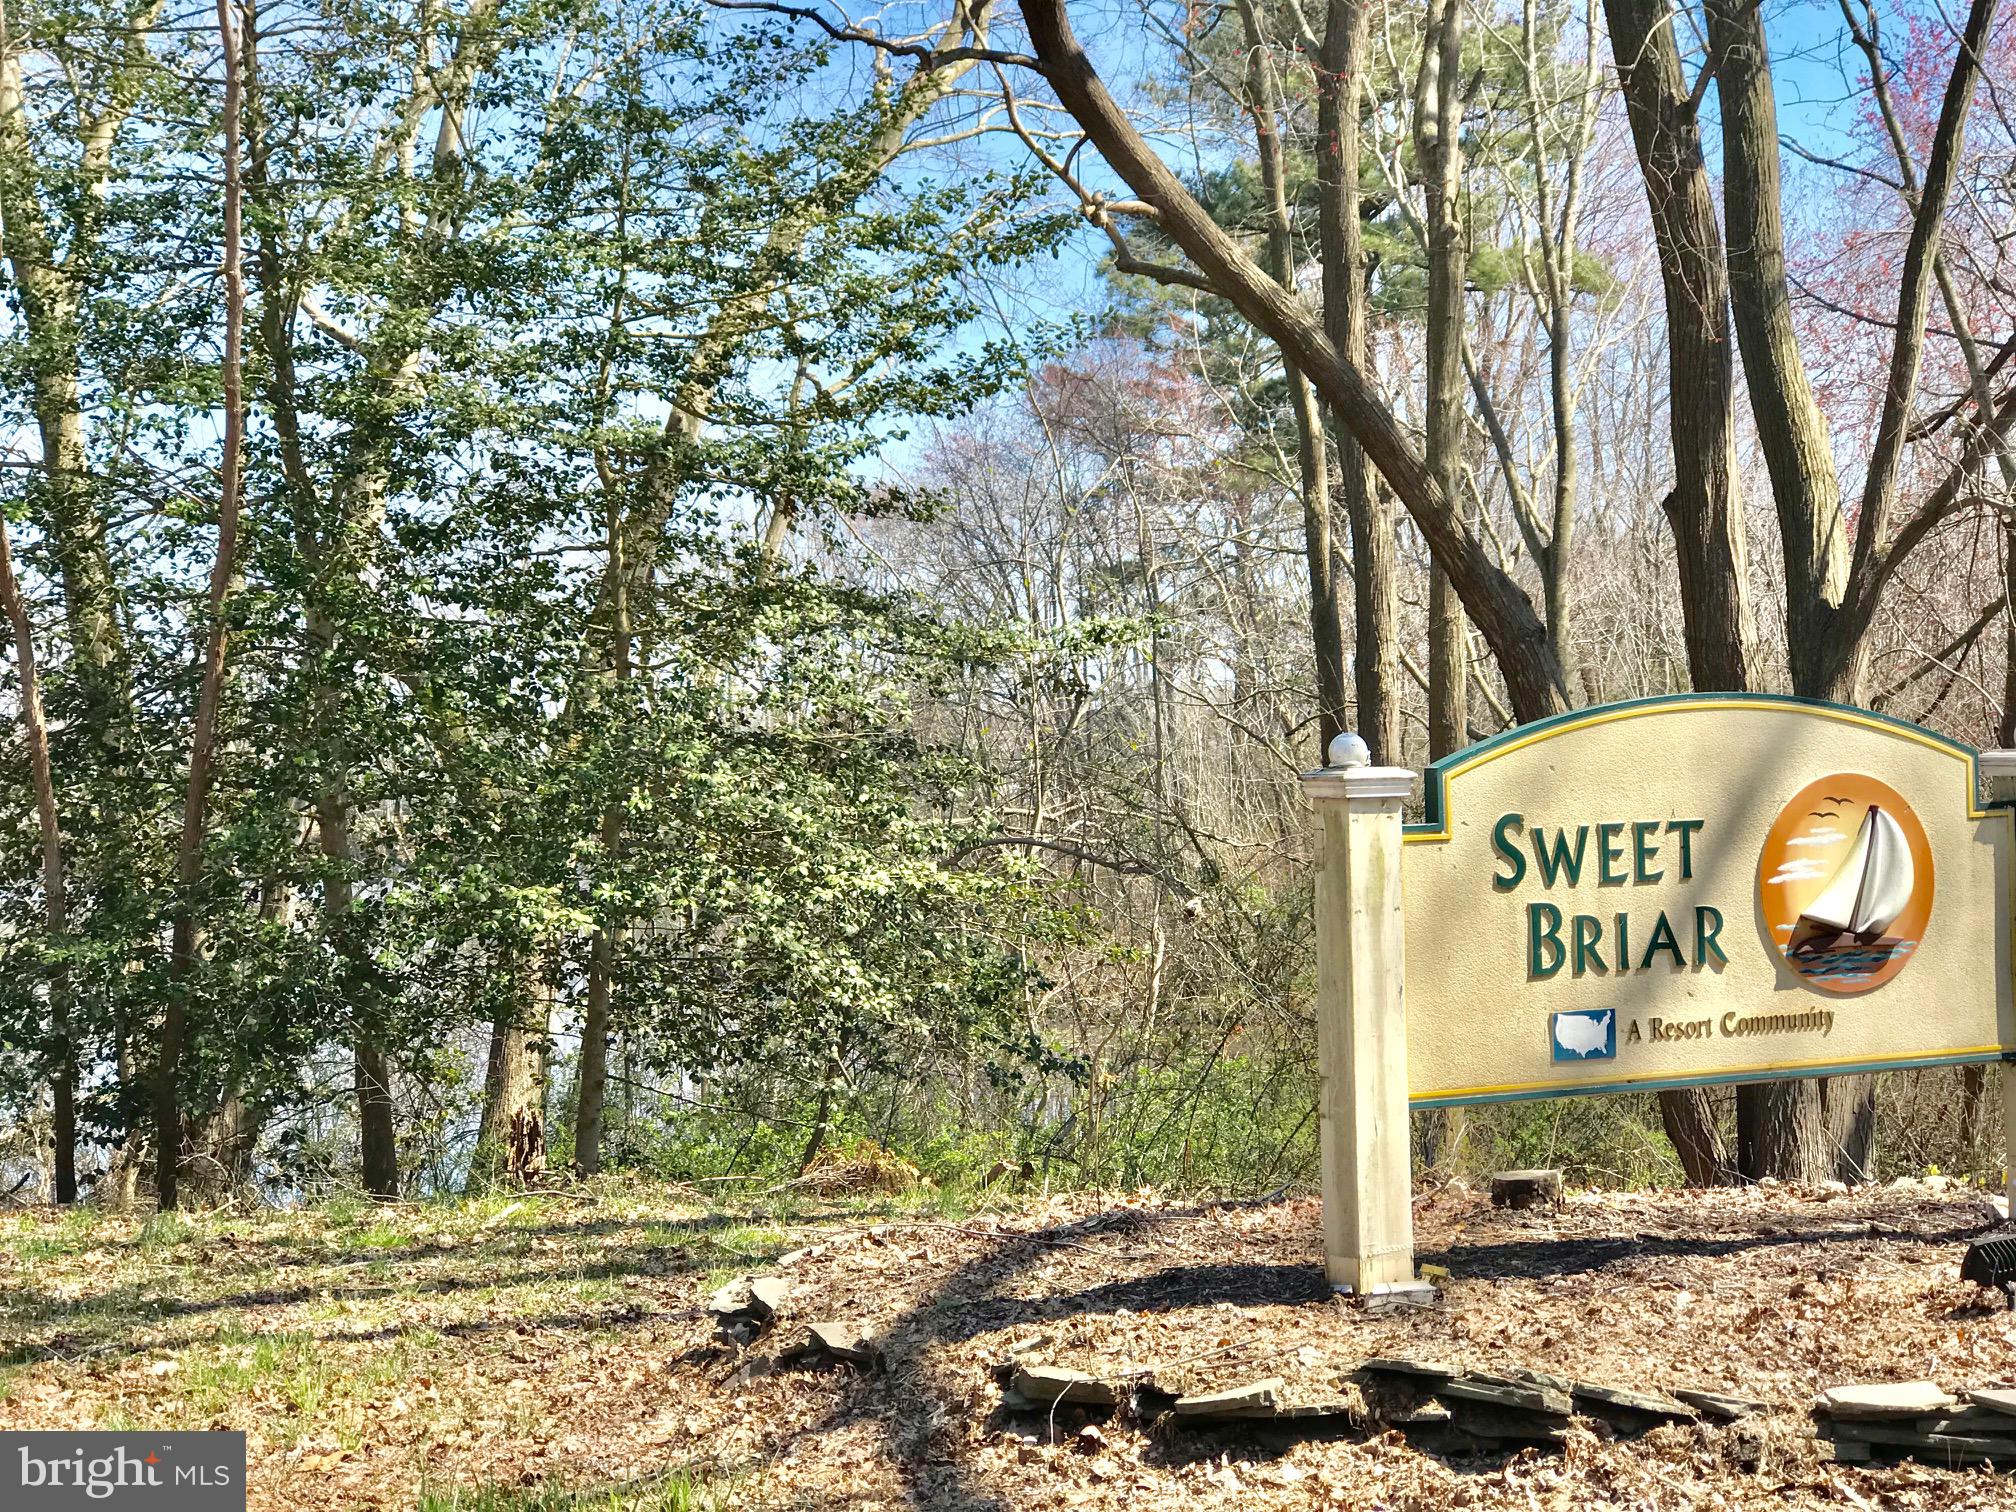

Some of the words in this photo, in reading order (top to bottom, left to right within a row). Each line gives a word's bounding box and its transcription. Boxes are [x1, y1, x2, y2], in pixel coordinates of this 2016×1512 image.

[1492, 812, 1705, 890] SWEET
[1526, 903, 1729, 980] BRIAR
[1627, 1018, 1642, 1041] A
[1650, 1016, 1713, 1042] Resort
[1720, 1007, 1835, 1037] Community
